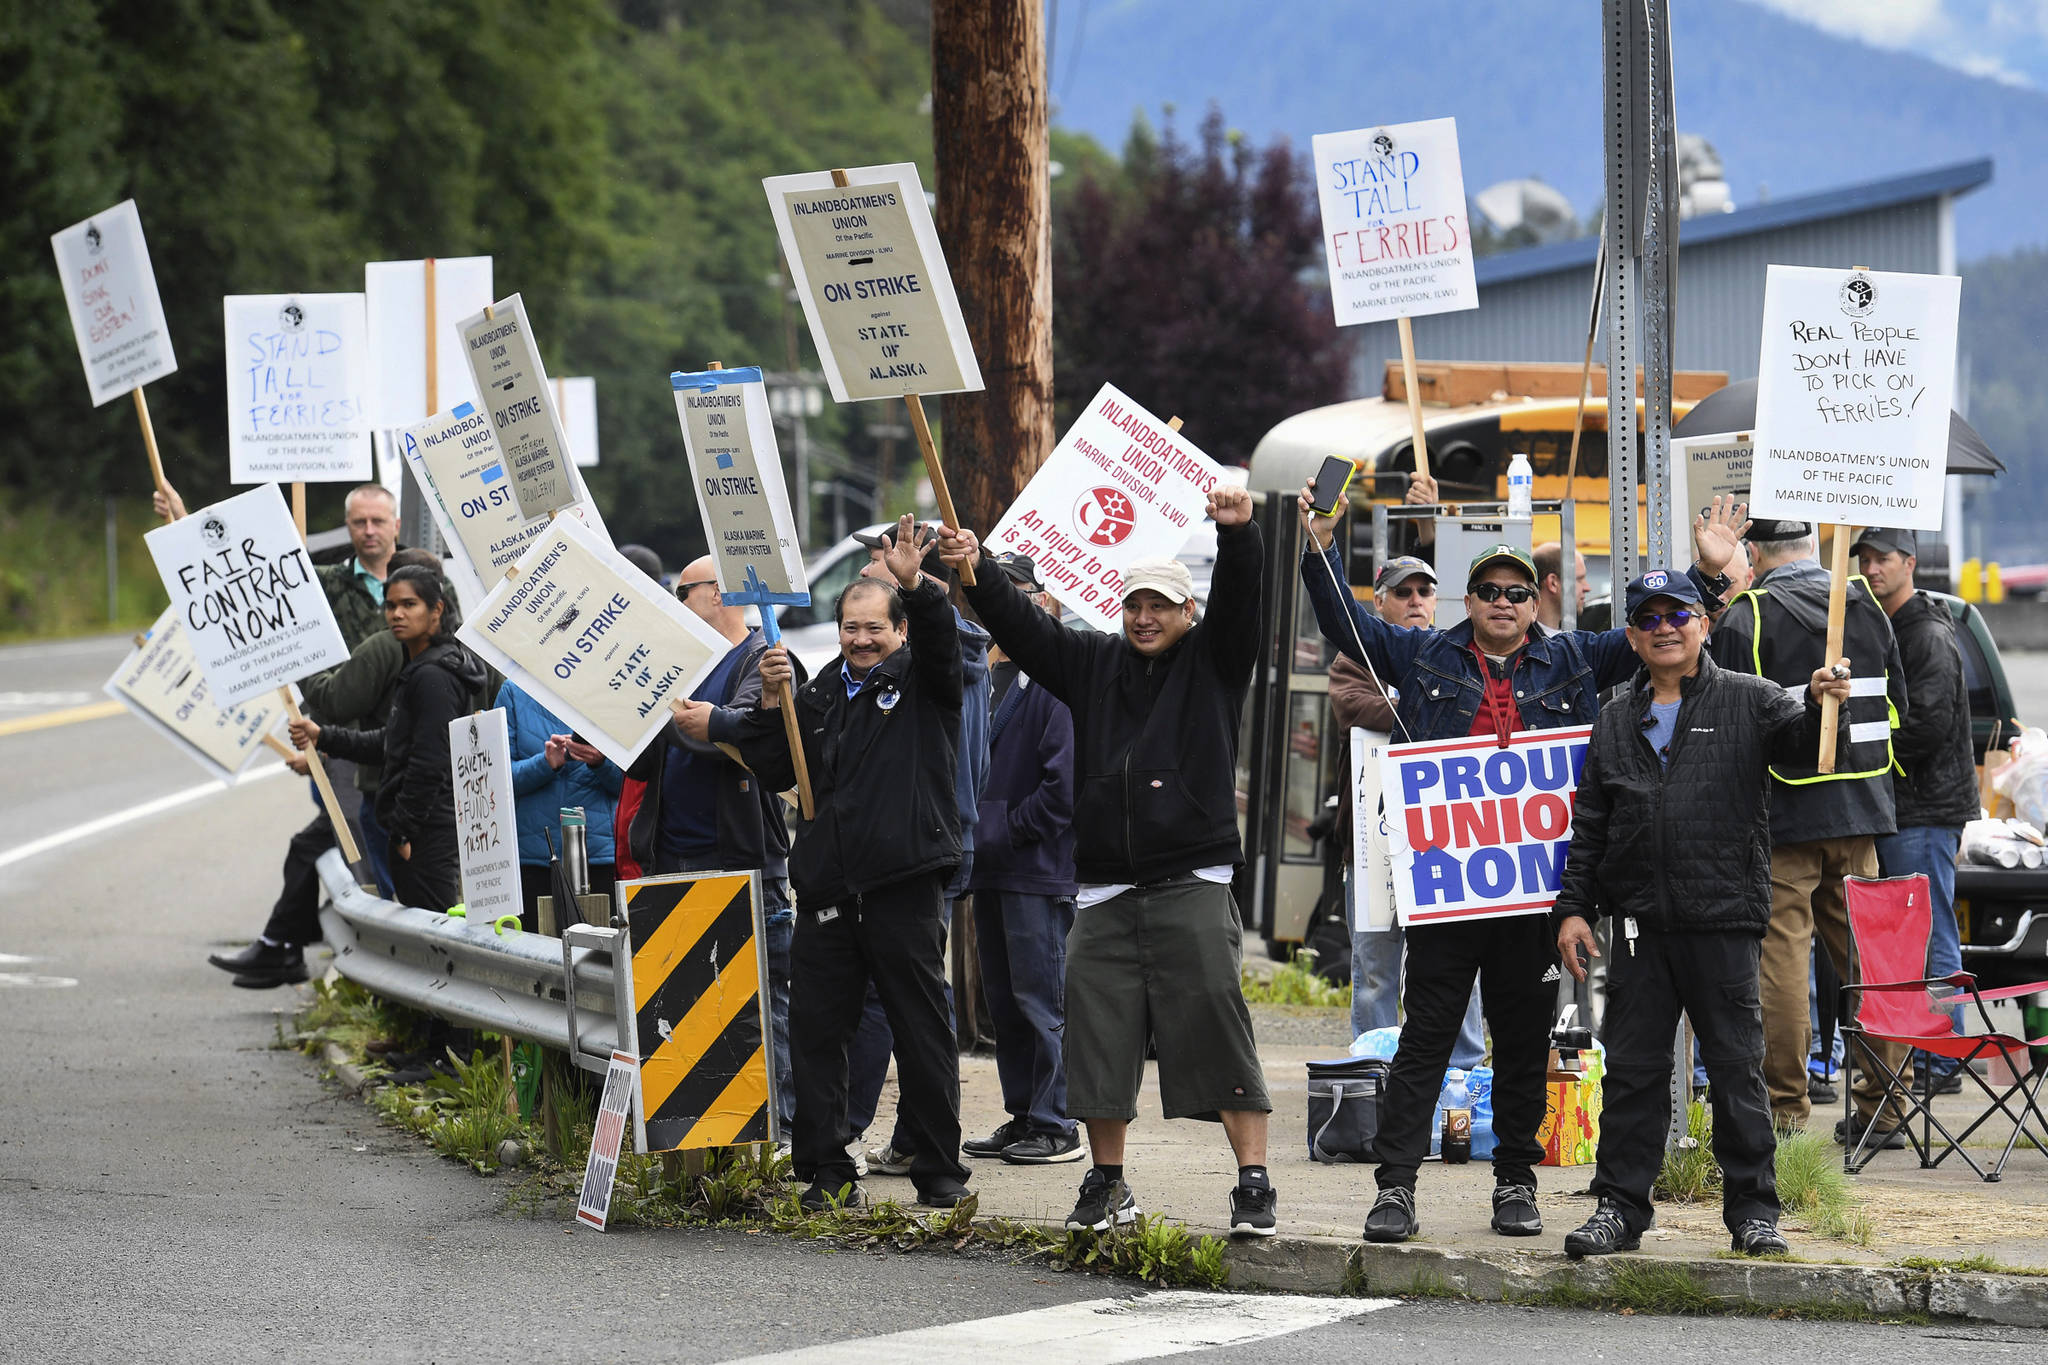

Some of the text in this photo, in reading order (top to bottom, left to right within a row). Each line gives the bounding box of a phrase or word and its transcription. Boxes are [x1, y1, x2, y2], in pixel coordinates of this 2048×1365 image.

[1332, 151, 1419, 189] STAND
[794, 193, 896, 215] INLANDBOATMEN'S
[1344, 181, 1421, 218] TALL
[832, 215, 868, 230] UNION
[854, 232, 873, 241] Pacific
[1333, 215, 1457, 267] FERRIES
[826, 252, 848, 260] MARINE
[850, 249, 874, 257] DIVISION
[1342, 258, 1461, 280] INLANDBOATMEN'S UNION
[824, 274, 921, 302] ON STRIKE
[1369, 274, 1437, 291] OF THE PACIFIC
[1352, 289, 1458, 309] MARINE DIVISION, ILWU
[871, 311, 890, 319] against
[470, 322, 518, 350] INLANDBOATMEN'S
[858, 324, 909, 340] STATE
[1790, 320, 1919, 346] REAL PEOPLE
[248, 330, 342, 363] STAND
[490, 344, 507, 360] UNION
[882, 344, 900, 358] OF
[1864, 349, 1907, 368] HAVE
[869, 362, 927, 380] ALASKA
[248, 364, 326, 402] TALL
[1803, 373, 1914, 392] TO PICK ON
[496, 396, 541, 428] ON STRIKE
[687, 395, 742, 408] INLANDBOATMEN'S
[423, 413, 485, 448] INLANDBOA
[707, 414, 726, 426] UNION
[329, 432, 358, 440] UNION
[1099, 399, 1217, 493] INLANDBOATMEN'S
[268, 447, 280, 455] OF
[301, 446, 334, 454] PACIFIC
[515, 447, 549, 468] ALASKA MARINE
[1692, 448, 1753, 461] INLANDBOA
[1769, 449, 1930, 469] INLANDBOATMEN'S UNION
[250, 463, 284, 471] MARINE
[518, 460, 555, 483] HIGHWAY SYSTEM
[1122, 444, 1168, 484] UNION
[1728, 460, 1752, 470] UNIO
[705, 476, 758, 497] ON STRIKE
[1073, 437, 1189, 528] MARINE DIVISION ILWU
[1803, 469, 1894, 486] OF THE PACIFIC
[461, 496, 488, 518] ON
[1775, 490, 1918, 509] MARINE DIVISION, ILWU
[489, 533, 524, 554] ALASKA
[723, 530, 766, 541] ALASKA MARINE
[1018, 510, 1044, 531] An
[1041, 524, 1082, 564] Injury
[1084, 554, 1102, 574] to
[725, 544, 772, 556] HIGHWAY SYSTEM
[178, 538, 265, 594] FAIR
[1001, 524, 1123, 619] is an Injury to All
[188, 548, 309, 631] CONTRACT
[487, 541, 568, 634] INLANDBOATMEN'S
[525, 581, 557, 614] UNION
[577, 586, 590, 601] ILWU
[544, 606, 553, 617] the
[550, 590, 568, 610] Pacific
[223, 593, 297, 649] NOW!
[210, 619, 321, 668] INLANDBOATMEN'S UNION
[553, 592, 630, 680] ON STRIKE
[240, 642, 303, 672] OF THE PACIFIC
[604, 642, 620, 661] against
[228, 676, 263, 694] MARINE
[264, 662, 303, 680] DIVISION,
[303, 650, 327, 665] ILWU
[609, 644, 651, 691] STATE
[634, 666, 654, 688] OF
[637, 665, 684, 718] ALASKA
[176, 703, 196, 721] ON
[457, 755, 478, 777] SAVE
[464, 795, 489, 824] FUND
[1405, 791, 1577, 853] UNIO
[491, 821, 500, 846] 2
[1410, 840, 1573, 906] HOM
[1542, 974, 1561, 982] adida
